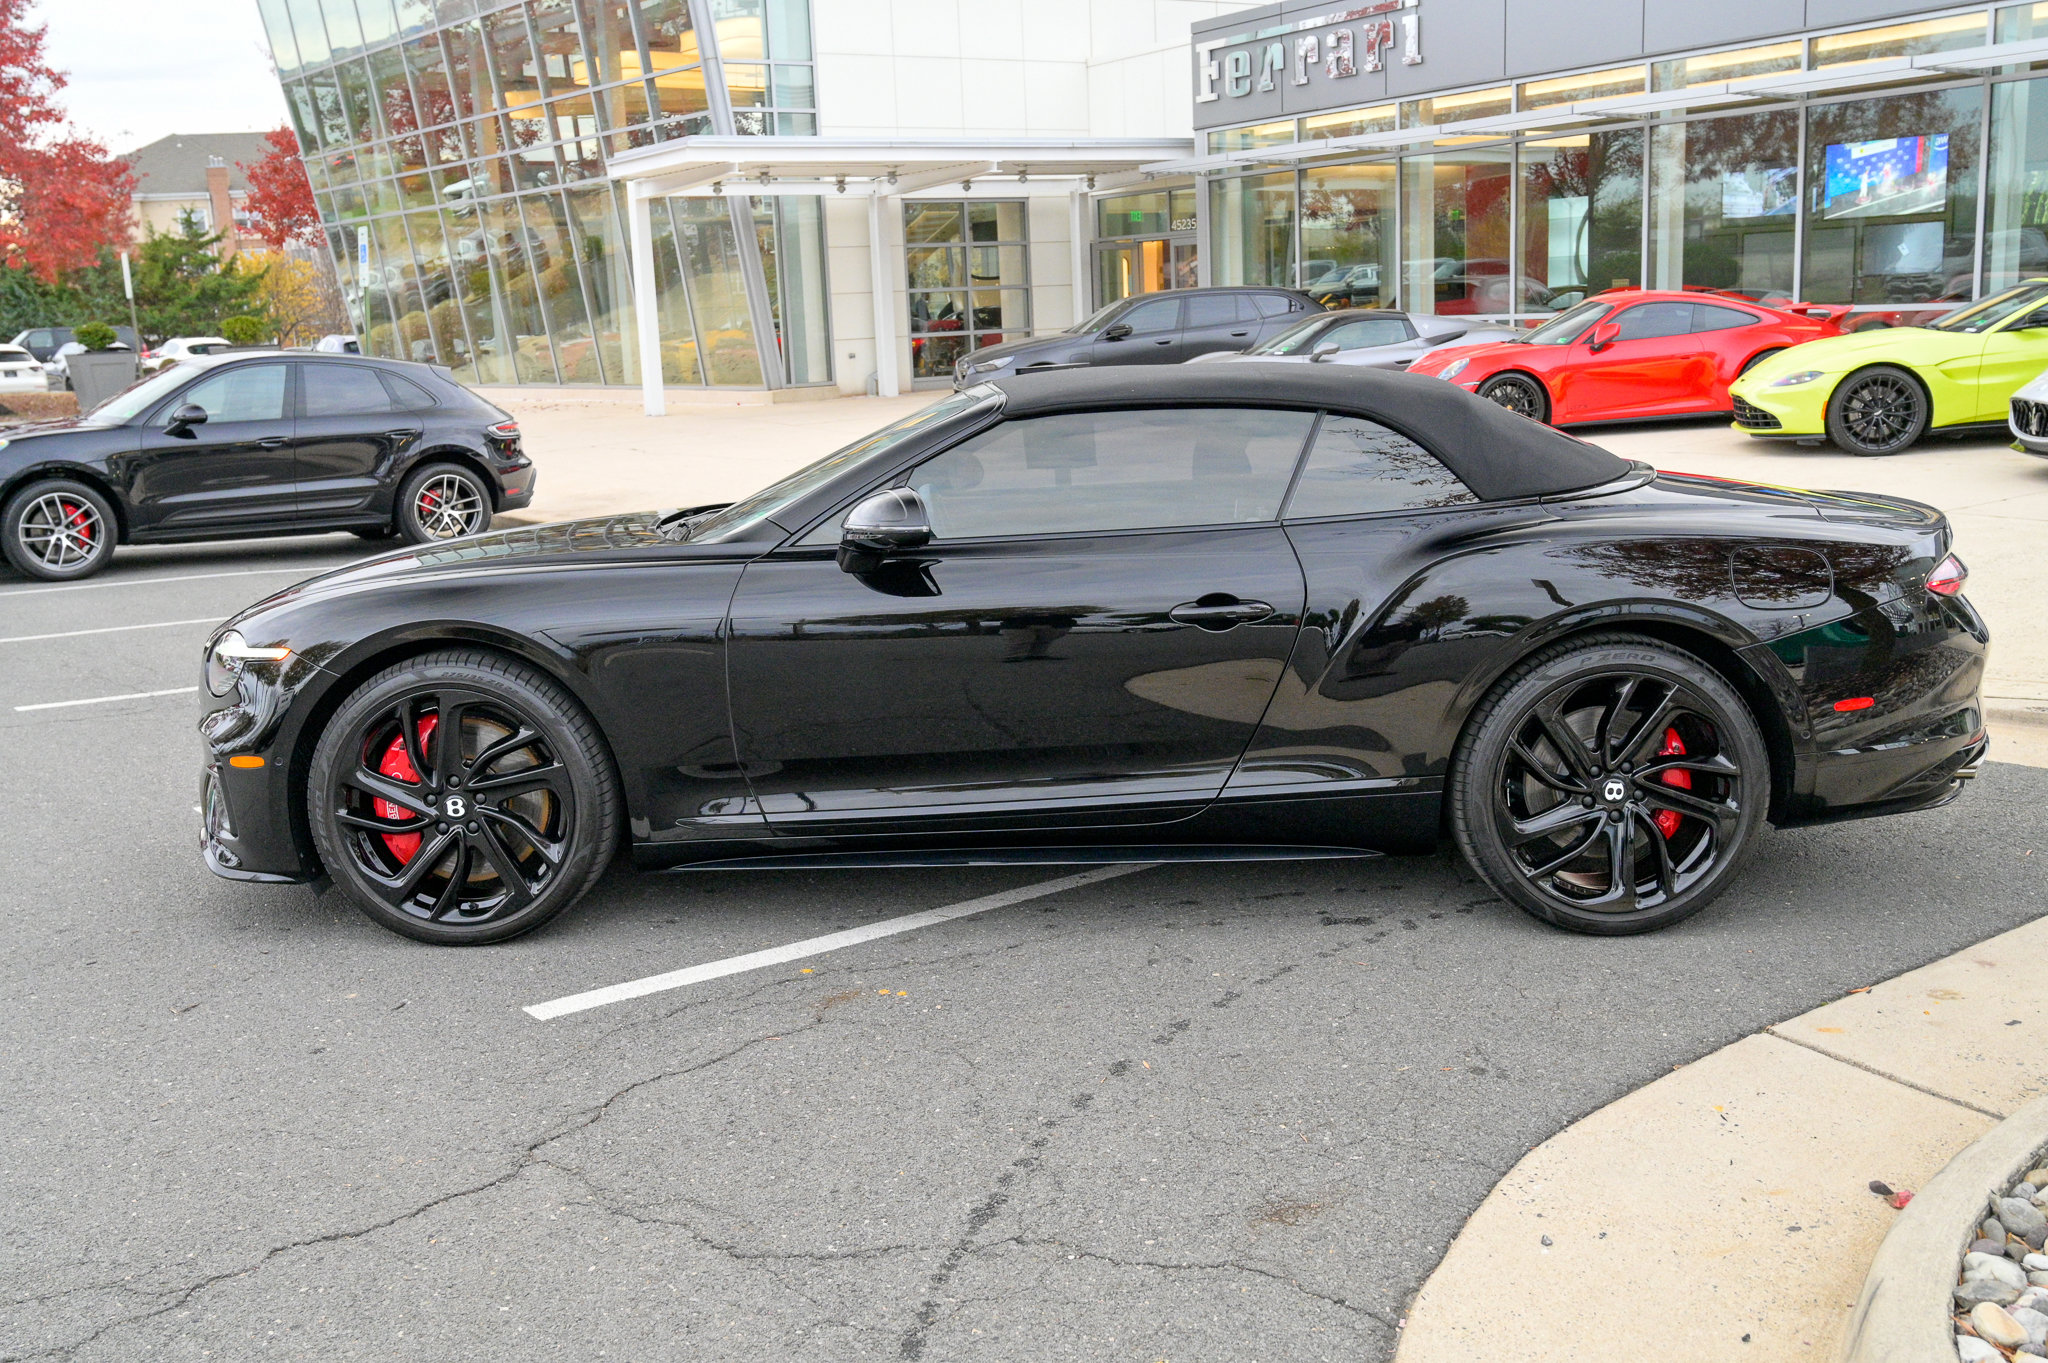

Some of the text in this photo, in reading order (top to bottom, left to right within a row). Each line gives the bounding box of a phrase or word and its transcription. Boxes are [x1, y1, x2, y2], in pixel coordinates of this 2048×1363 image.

[1196, 0, 1422, 103] Ferrari
[1171, 218, 1197, 230] 45235
[1599, 652, 1656, 662] ZERO
[1604, 782, 1625, 800] B
[446, 798, 465, 817] B
